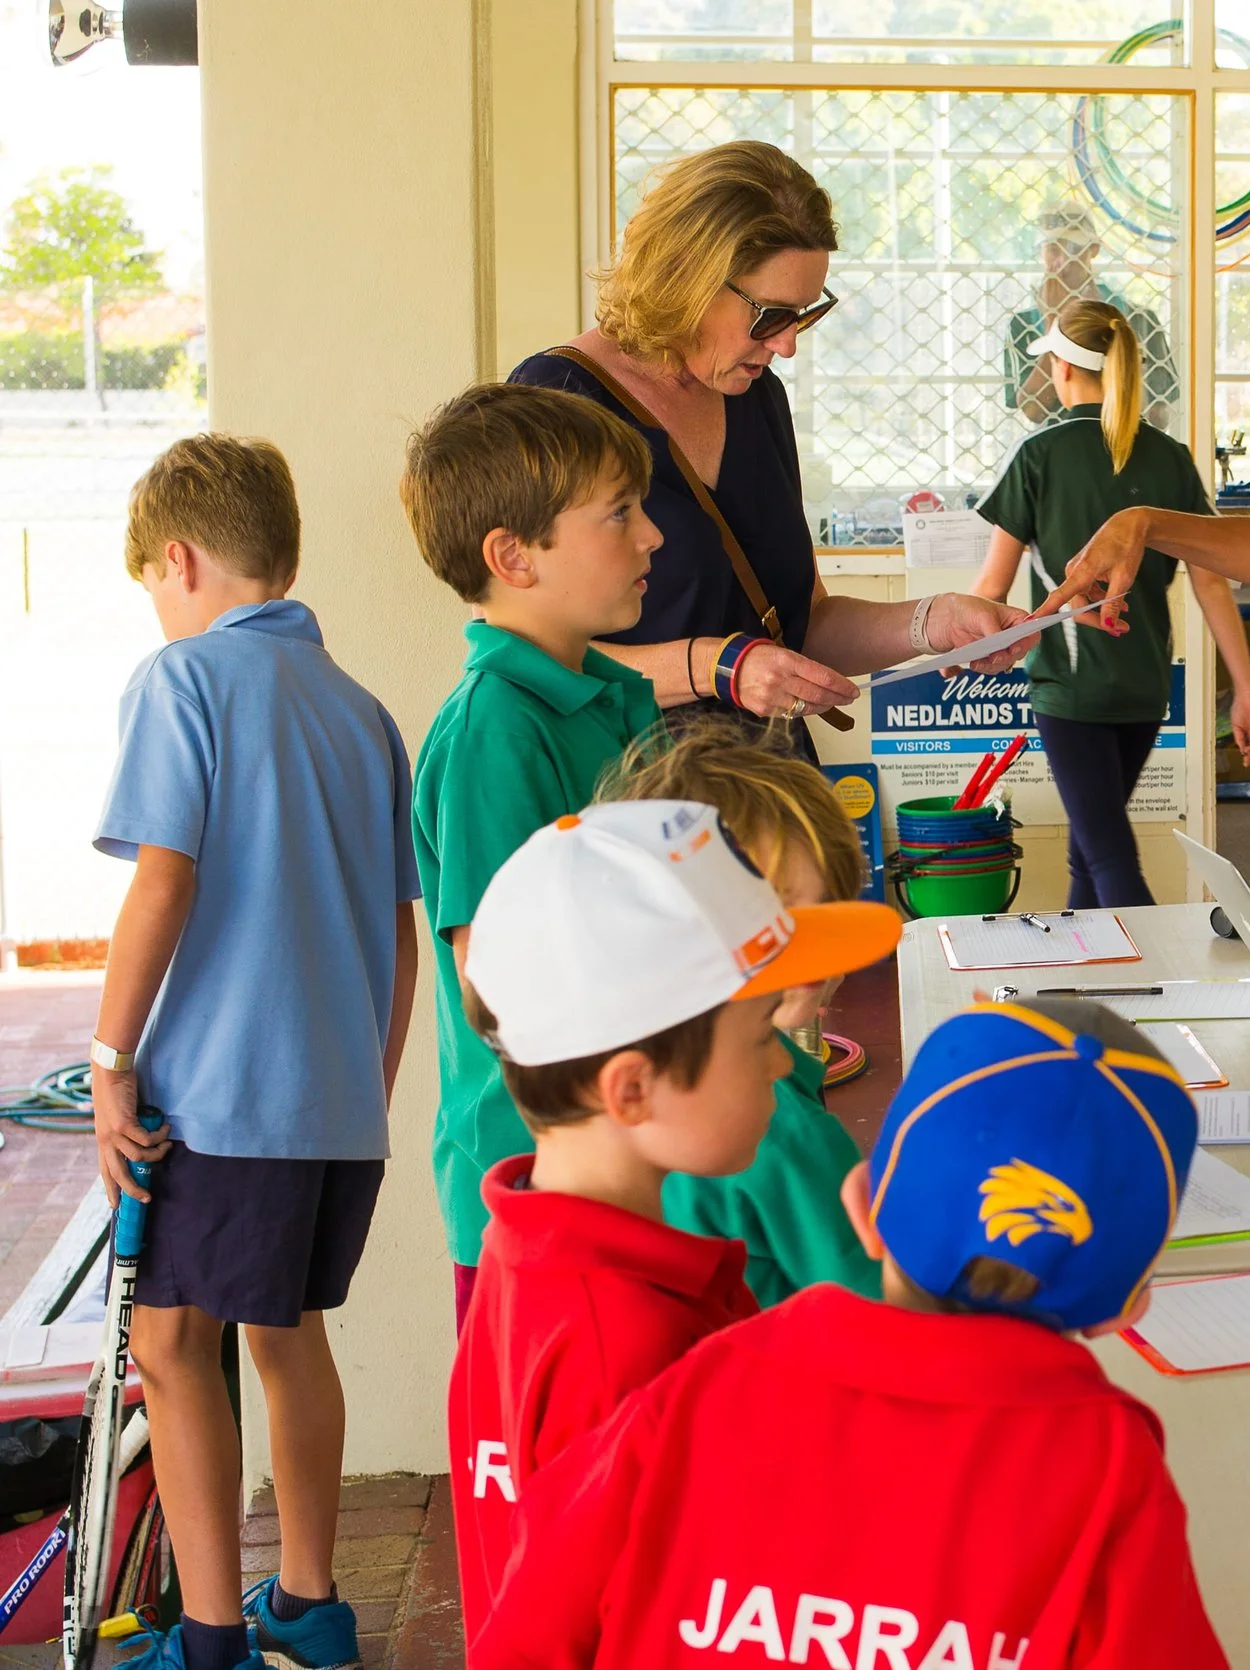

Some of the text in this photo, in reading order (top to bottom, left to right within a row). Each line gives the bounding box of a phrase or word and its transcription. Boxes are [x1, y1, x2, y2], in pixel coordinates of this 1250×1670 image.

[942, 675, 1030, 701] Welcom
[887, 702, 1013, 727] NEDLANDS
[896, 741, 951, 751] VISITORS
[942, 762, 949, 770] by
[115, 1277, 136, 1381] HEAD
[4, 1529, 66, 1615] PRO ROOKI
[679, 1578, 1030, 1670] JARRAH
